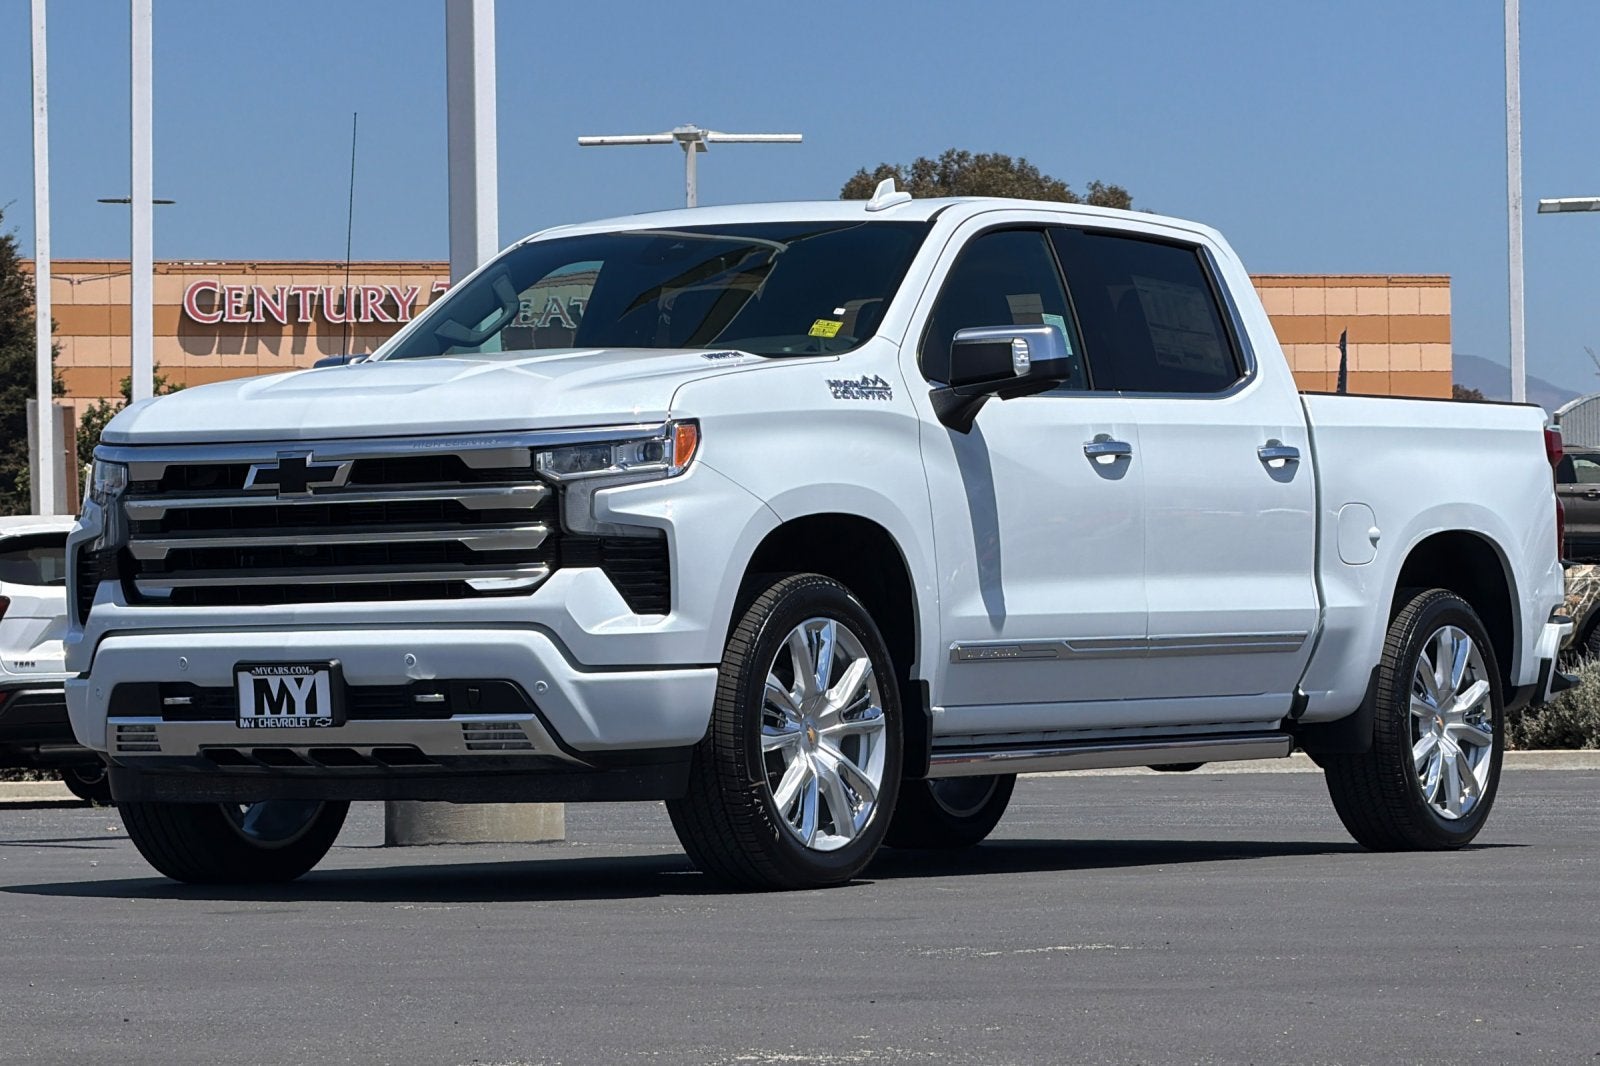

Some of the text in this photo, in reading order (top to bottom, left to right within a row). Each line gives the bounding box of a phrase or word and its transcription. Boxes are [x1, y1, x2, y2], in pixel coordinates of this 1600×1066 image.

[184, 280, 421, 324] CENTURY
[255, 666, 310, 675] MYCARS.COM
[253, 677, 318, 716] MY
[258, 718, 311, 728] CHEVROLET
